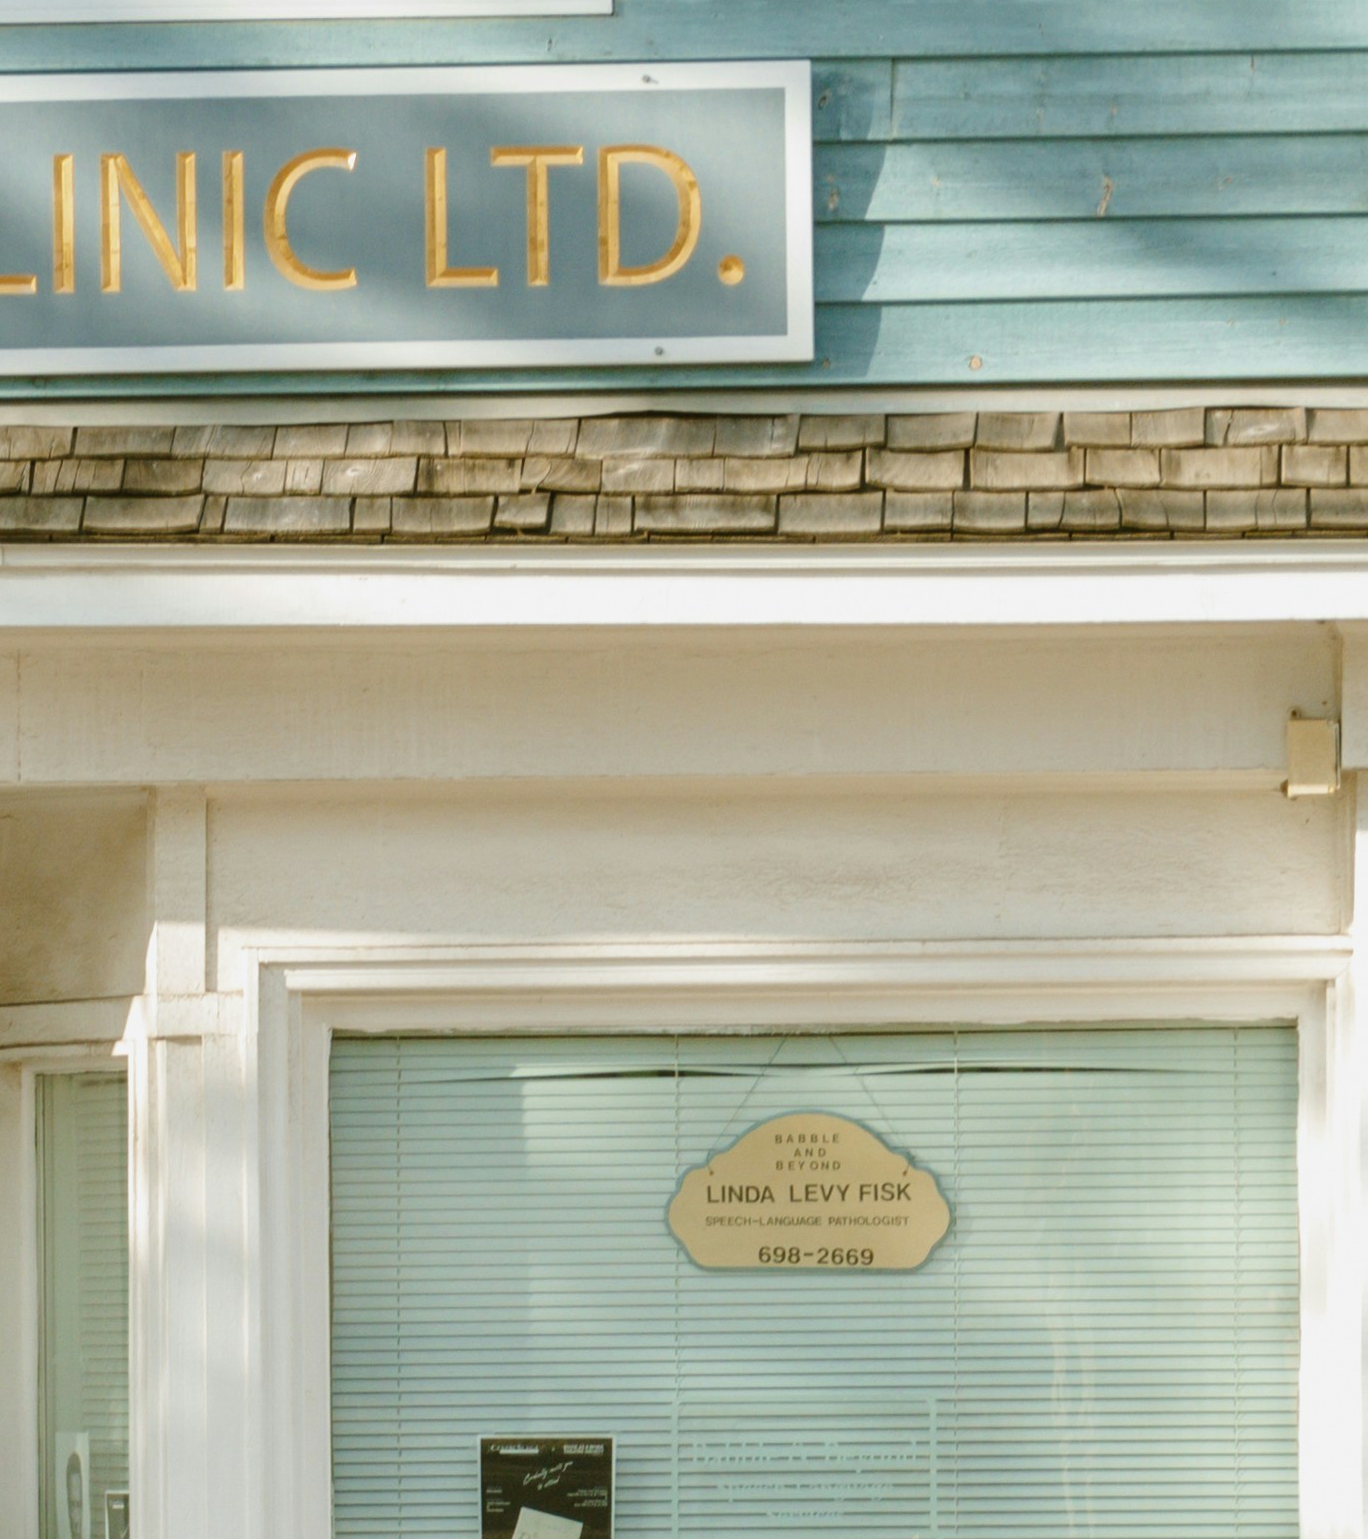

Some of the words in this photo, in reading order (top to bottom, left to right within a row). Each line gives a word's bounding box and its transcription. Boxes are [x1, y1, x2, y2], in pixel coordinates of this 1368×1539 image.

[425, 144, 745, 287] LTD.
[774, 1133, 841, 1145] BABBLE
[793, 1147, 827, 1158] AND
[775, 1160, 842, 1172] BEYOND
[705, 1183, 776, 1205] LINDA
[788, 1183, 851, 1204] LEVY
[858, 1181, 913, 1203] FISK
[704, 1214, 823, 1228] SPEECH-LANGUAGE
[828, 1214, 911, 1228] PATHOLOGIST
[757, 1246, 875, 1267] 698-2669
